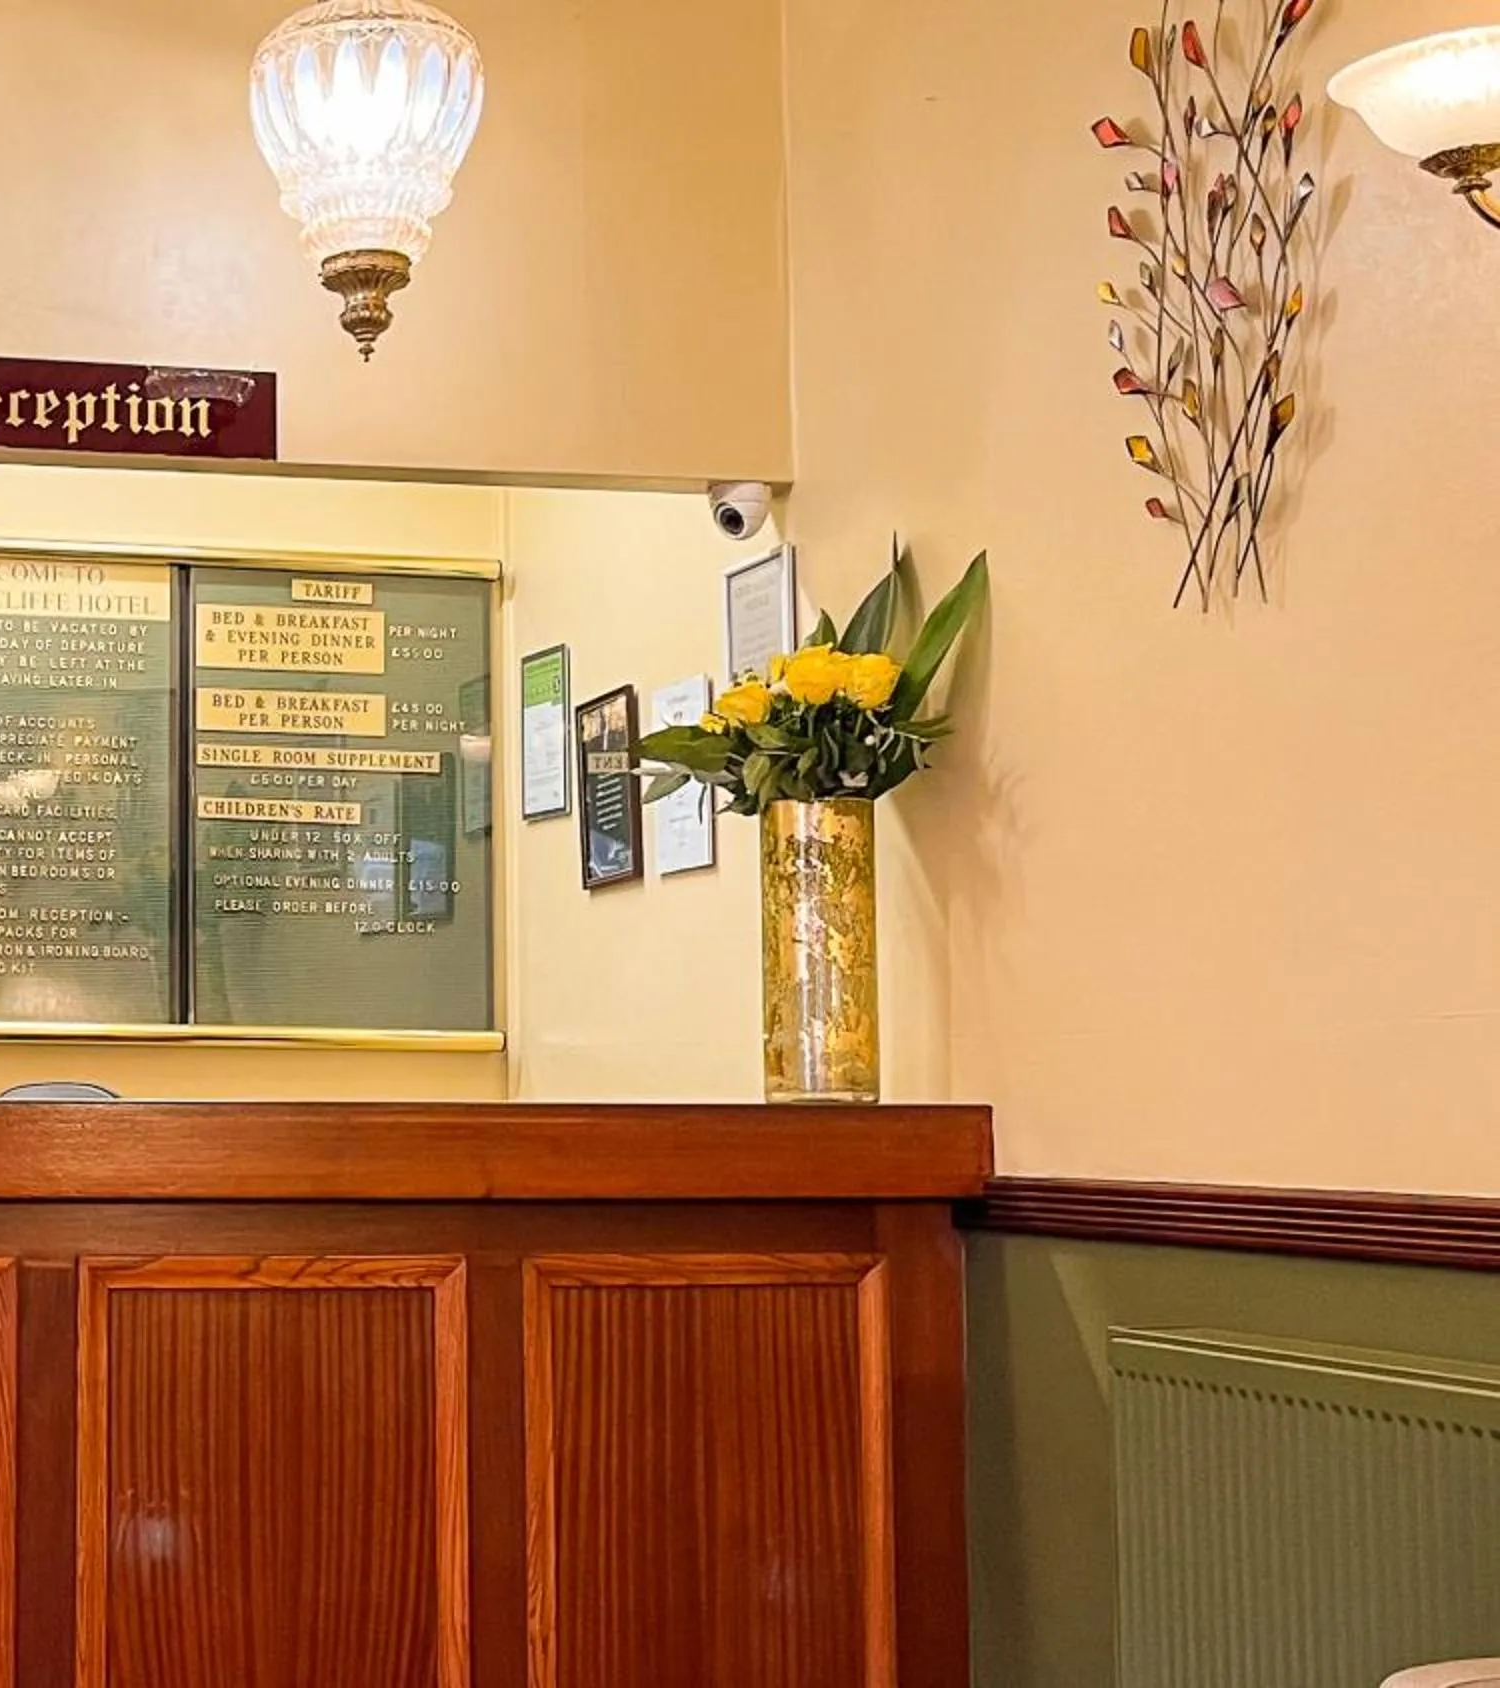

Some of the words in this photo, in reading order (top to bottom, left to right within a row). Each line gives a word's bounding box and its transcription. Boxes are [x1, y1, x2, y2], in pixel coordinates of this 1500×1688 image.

[72, 565, 105, 586] TO
[301, 583, 361, 599] TARIFF
[78, 593, 158, 615] HOTEL
[23, 620, 40, 633] BE
[50, 621, 117, 636] VACATED
[129, 624, 148, 637] BY
[212, 611, 245, 625] BED
[254, 613, 265, 626] &
[276, 614, 371, 631] BREAKFAST
[205, 629, 216, 642] &
[227, 630, 300, 646] EVENING
[311, 633, 375, 649] DINNER
[389, 625, 411, 637] PER
[417, 627, 457, 639] NIGHT
[0, 637, 29, 650] DAY
[35, 639, 52, 651] OF
[60, 640, 145, 654] DEPARTURE
[19, 655, 37, 669] BE
[49, 657, 86, 670] LEFT
[95, 659, 111, 671] AT
[117, 660, 146, 672] THE
[238, 650, 269, 662] PER
[281, 651, 344, 665] PERSON
[49, 675, 93, 688] LATER
[103, 676, 118, 689] IN
[212, 693, 245, 709] BED
[255, 695, 266, 709] &
[277, 697, 370, 713] BREAKFAST
[19, 716, 97, 730] ACCOUNTS
[239, 713, 269, 727] PER
[281, 715, 345, 729] PERSON
[391, 719, 419, 732] PER
[425, 719, 466, 733] NIGHT
[74, 735, 139, 750] PAYMENT
[65, 752, 139, 768] PERSONAL
[201, 748, 262, 763] SINGLE
[273, 751, 316, 765] ROOM
[327, 752, 435, 769] SUPPLEMENT
[298, 775, 325, 788] PER
[331, 776, 357, 789] DAY
[203, 801, 303, 818] CHILDREN'S
[314, 805, 356, 821] RATE
[58, 831, 113, 844] ACCEPT
[249, 828, 299, 841] UNDER
[305, 831, 321, 843] 12
[373, 833, 402, 846] OFF
[18, 847, 45, 860] FOR
[50, 848, 94, 861] ITEMS
[99, 849, 116, 862] OF
[248, 847, 302, 860] SHARING
[307, 849, 339, 861] WITH
[363, 850, 417, 864] ADULTS
[11, 865, 90, 879] BEDROOMS
[97, 867, 115, 879] OR
[213, 873, 281, 888] OPTIONAL
[285, 875, 341, 890] EVENING
[346, 878, 394, 892] DINNER
[272, 901, 317, 914] ORDER
[325, 901, 375, 916] BEFORE
[51, 926, 77, 939] FOR
[41, 945, 99, 958] IRONING
[103, 945, 150, 959] BOARD
[11, 963, 35, 974] KIT
